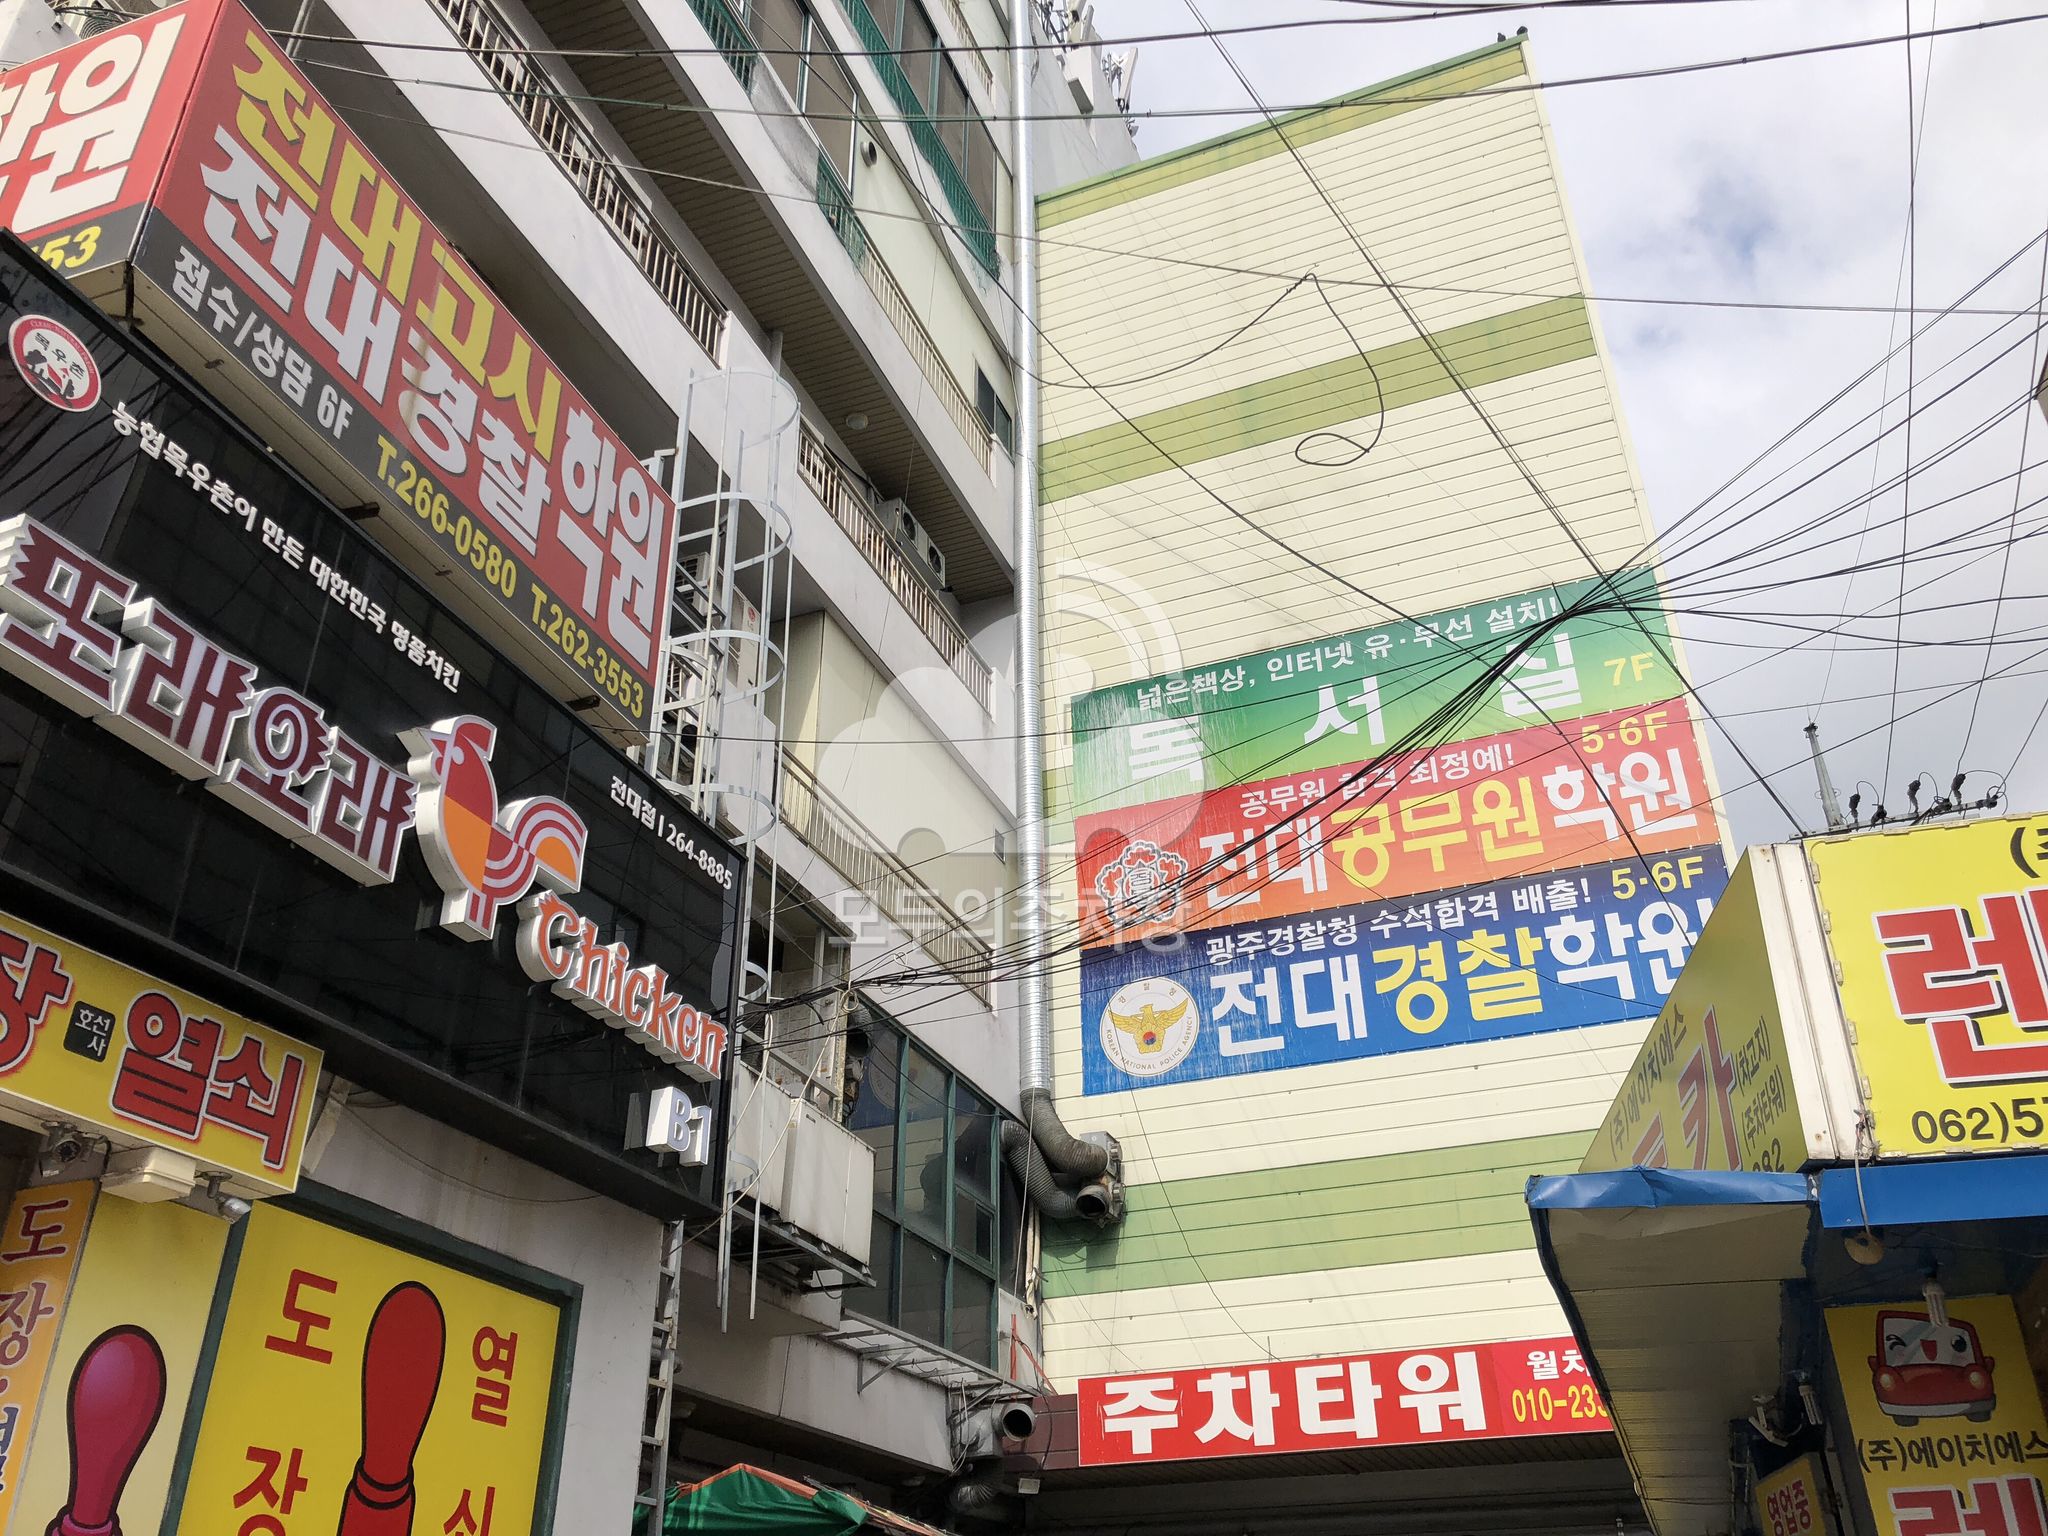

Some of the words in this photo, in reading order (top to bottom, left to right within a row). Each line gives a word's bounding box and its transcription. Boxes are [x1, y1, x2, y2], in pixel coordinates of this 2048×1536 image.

[232, 29, 562, 463] 전대고시
[172, 245, 313, 408] 접수/상담
[317, 383, 353, 440] 6F
[200, 124, 552, 557] 전대경찰
[112, 401, 258, 532] 농협목우촌이
[262, 517, 306, 570] 만든
[309, 555, 388, 634] 대한민국
[391, 620, 461, 693] 명품치킨
[376, 433, 517, 598] T.266-0580
[530, 583, 644, 719] T.262-3553
[556, 406, 666, 670] 학원
[0, 513, 420, 884] 또래오래
[1137, 665, 1255, 711] 넓은책상,
[1266, 639, 1354, 681] 인터넷
[1364, 614, 1474, 660] 유·무선
[1485, 596, 1558, 635] 설치!
[1603, 652, 1655, 687] 7F
[611, 775, 656, 830] 전대점
[667, 823, 734, 891] 264-8885
[1239, 777, 1326, 819] 공무원
[1338, 766, 1399, 801] 합격
[1409, 743, 1515, 786] 최정예!
[534, 890, 729, 1081] Chicken
[1206, 915, 1358, 967] 광주경찰청
[1370, 891, 1501, 939] 수석합격
[1512, 878, 1592, 915] 배출!
[110, 989, 305, 1170] 열쇠
[1609, 1002, 1688, 1163] (주)에이치에스
[1735, 1015, 1771, 1096] (차고지)
[1742, 1064, 1787, 1157] (주차타워)
[658, 1087, 713, 1166] B1
[1102, 1350, 1488, 1455] 주차타워
[1857, 1430, 2048, 1473] (주)에이치에스
